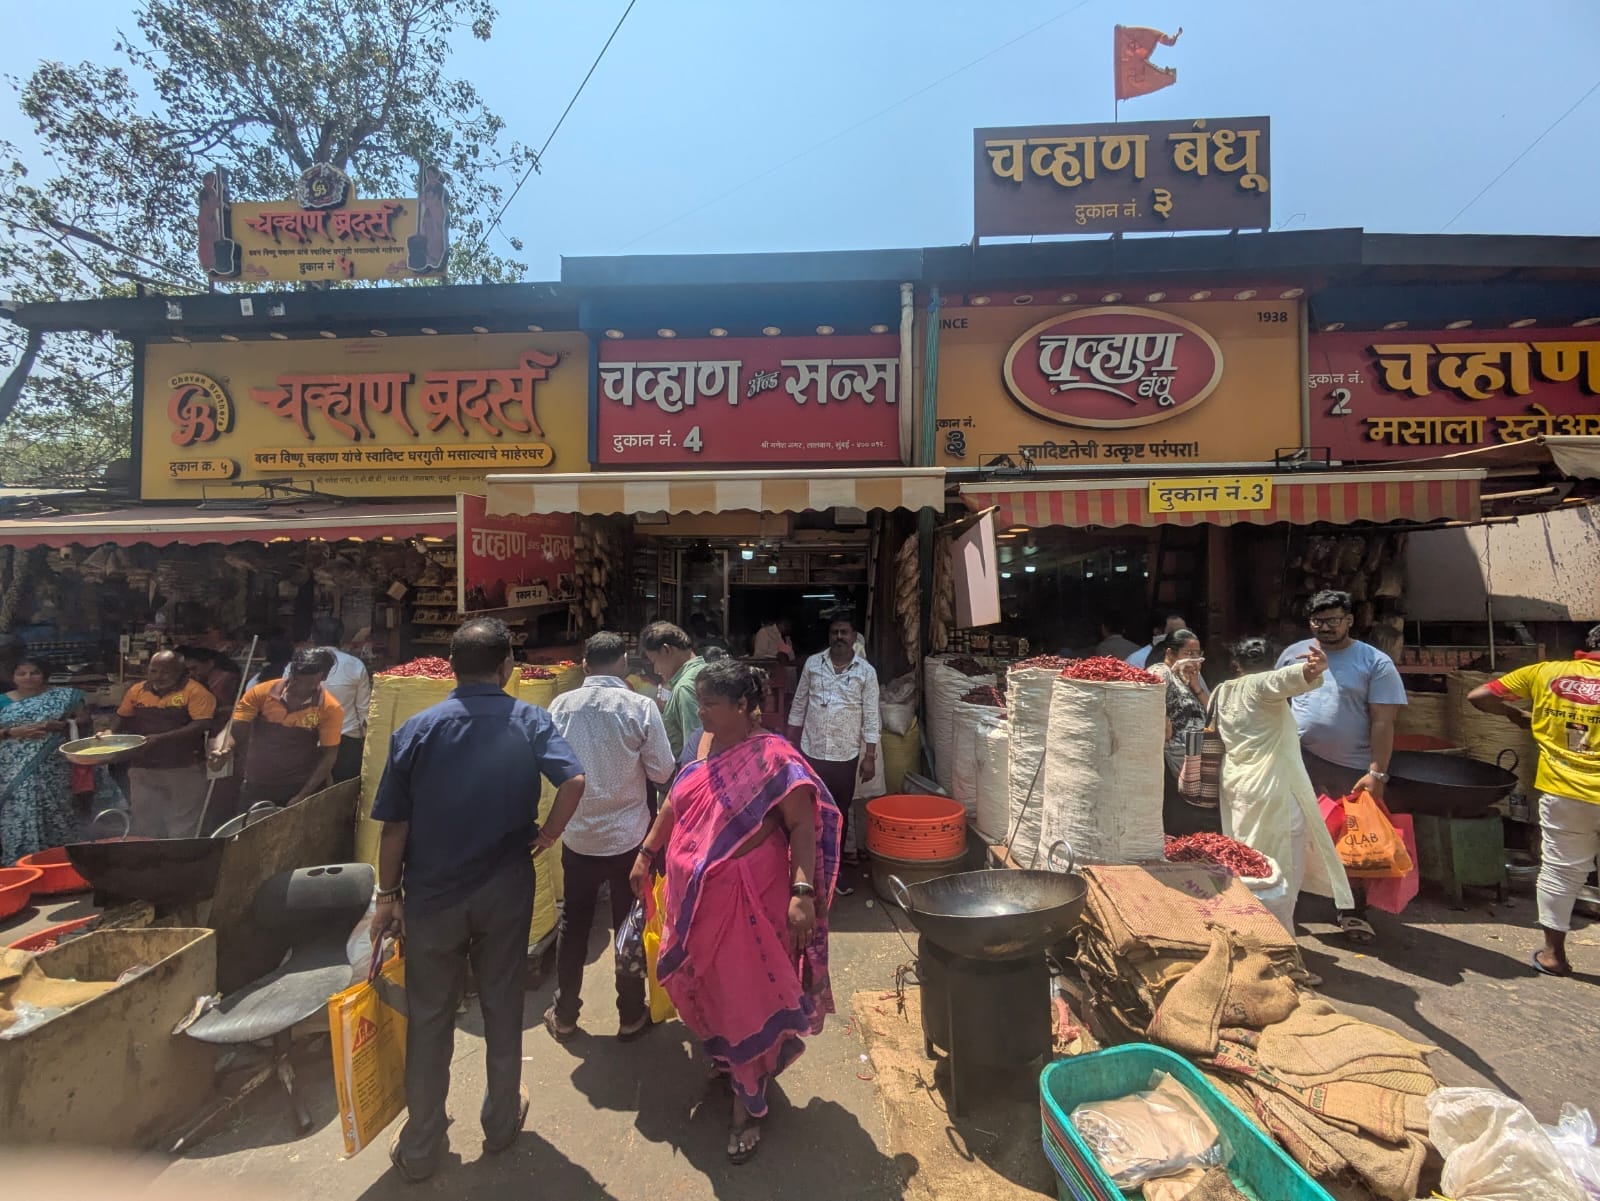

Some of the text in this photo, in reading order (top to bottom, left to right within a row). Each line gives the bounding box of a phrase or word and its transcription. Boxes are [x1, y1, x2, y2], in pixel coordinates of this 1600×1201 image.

[984, 119, 1269, 193] चव्हाण बंधू
[1075, 187, 1174, 225] दुकान नं. ३
[244, 201, 400, 239] चव्हाण ब्रदर्स
[299, 261, 324, 275] दुकान
[939, 318, 969, 329] INCE
[1257, 311, 1288, 323] 1938
[1039, 333, 1183, 384] चव्हाण
[1371, 341, 1600, 400] चव्हाण
[171, 376, 206, 386] Chavan
[599, 359, 742, 413] चव्हाण
[781, 358, 899, 404] सन्स
[1138, 372, 1176, 406] बंधू
[1308, 369, 1364, 389] दुकान नं.
[249, 350, 560, 438] चव्हाण ब्रदर्स
[1331, 388, 1353, 414] 2
[963, 416, 976, 428] नं.
[1367, 416, 1487, 444] मसाला
[612, 426, 703, 453] दुकान नं. 4
[946, 430, 968, 457] ३
[1102, 443, 1146, 462] उत्कृष्ट
[1149, 440, 1199, 457] परंपरा!
[169, 461, 199, 477] दुकान
[201, 460, 216, 472] क्र.
[255, 445, 545, 468] बबन विष्णू चव्हाण यांचे स्वादिष्ट घरगुती मसाल्याचे माहेरघर
[1158, 484, 1217, 511] दुकान
[471, 527, 528, 561] चव्हाण
